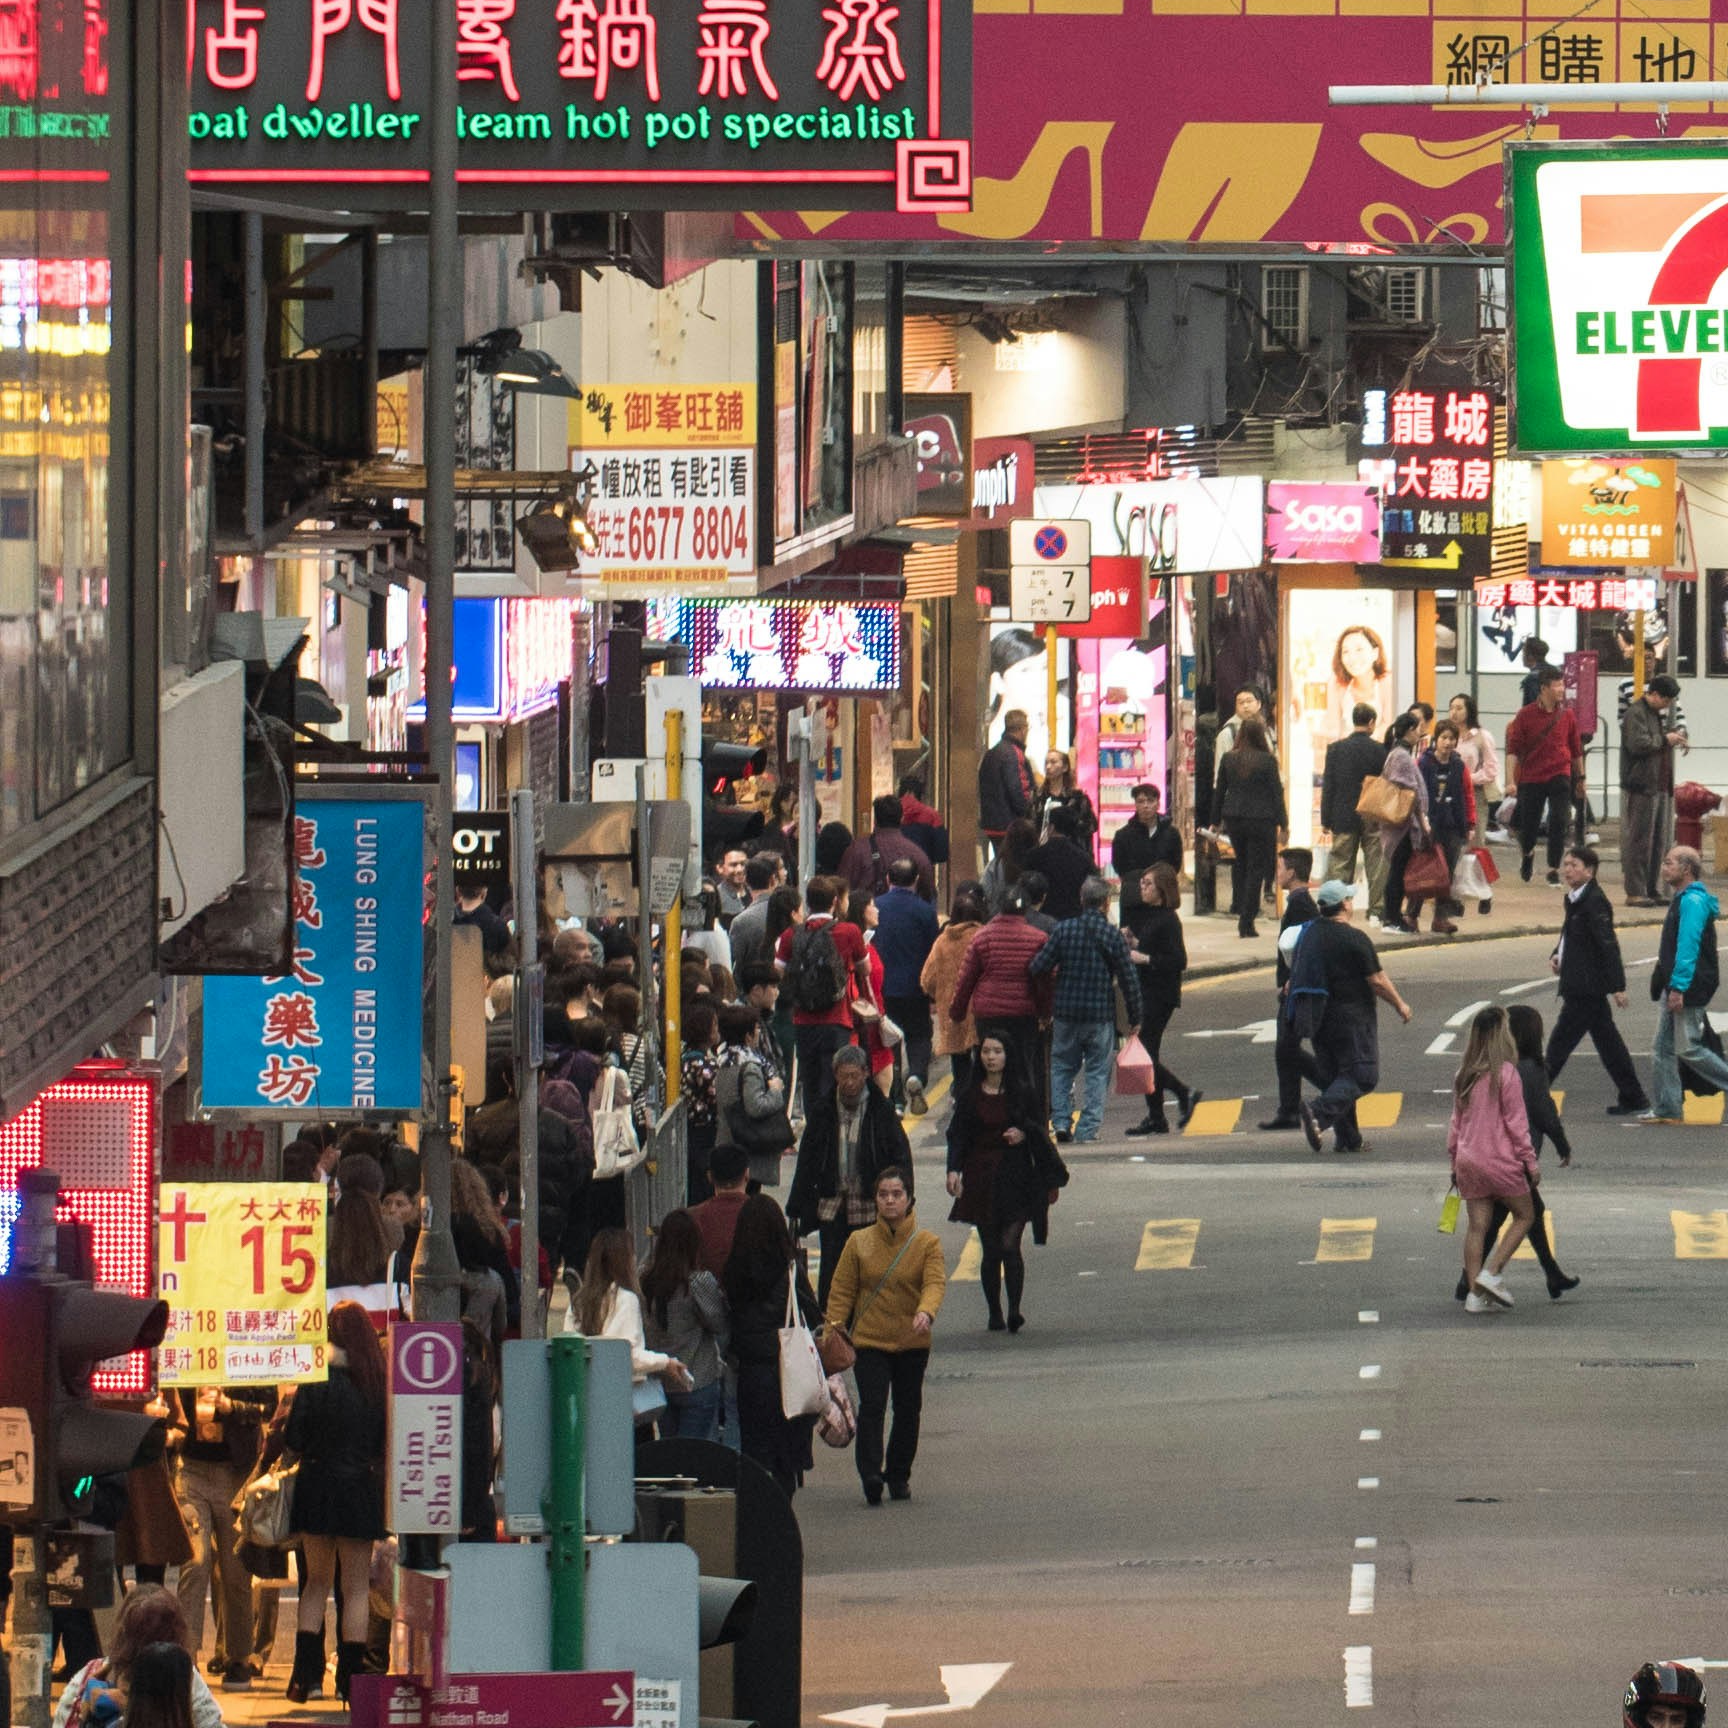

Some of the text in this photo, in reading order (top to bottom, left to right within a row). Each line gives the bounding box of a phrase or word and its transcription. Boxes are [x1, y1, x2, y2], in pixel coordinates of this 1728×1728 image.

[188, 103, 915, 149] oat dweller team hot pot specialist
[1391, 391, 1489, 446] 龍城
[1397, 455, 1492, 501] 大藥房
[628, 505, 685, 561] 6677
[692, 505, 748, 561] 8804
[1061, 570, 1074, 588] 7
[1061, 600, 1074, 618] 7
[452, 830, 501, 854] OT
[351, 818, 378, 1108] LUNG SHING MEDICINE
[239, 1197, 322, 1222] 大大杯
[240, 1225, 316, 1295] 15
[196, 1310, 217, 1333] 18
[302, 1308, 323, 1332] 20
[197, 1346, 218, 1370] 18
[401, 1430, 426, 1502] Tsim
[429, 1403, 453, 1526] Sha Tsui
[476, 1710, 510, 1725] Road
